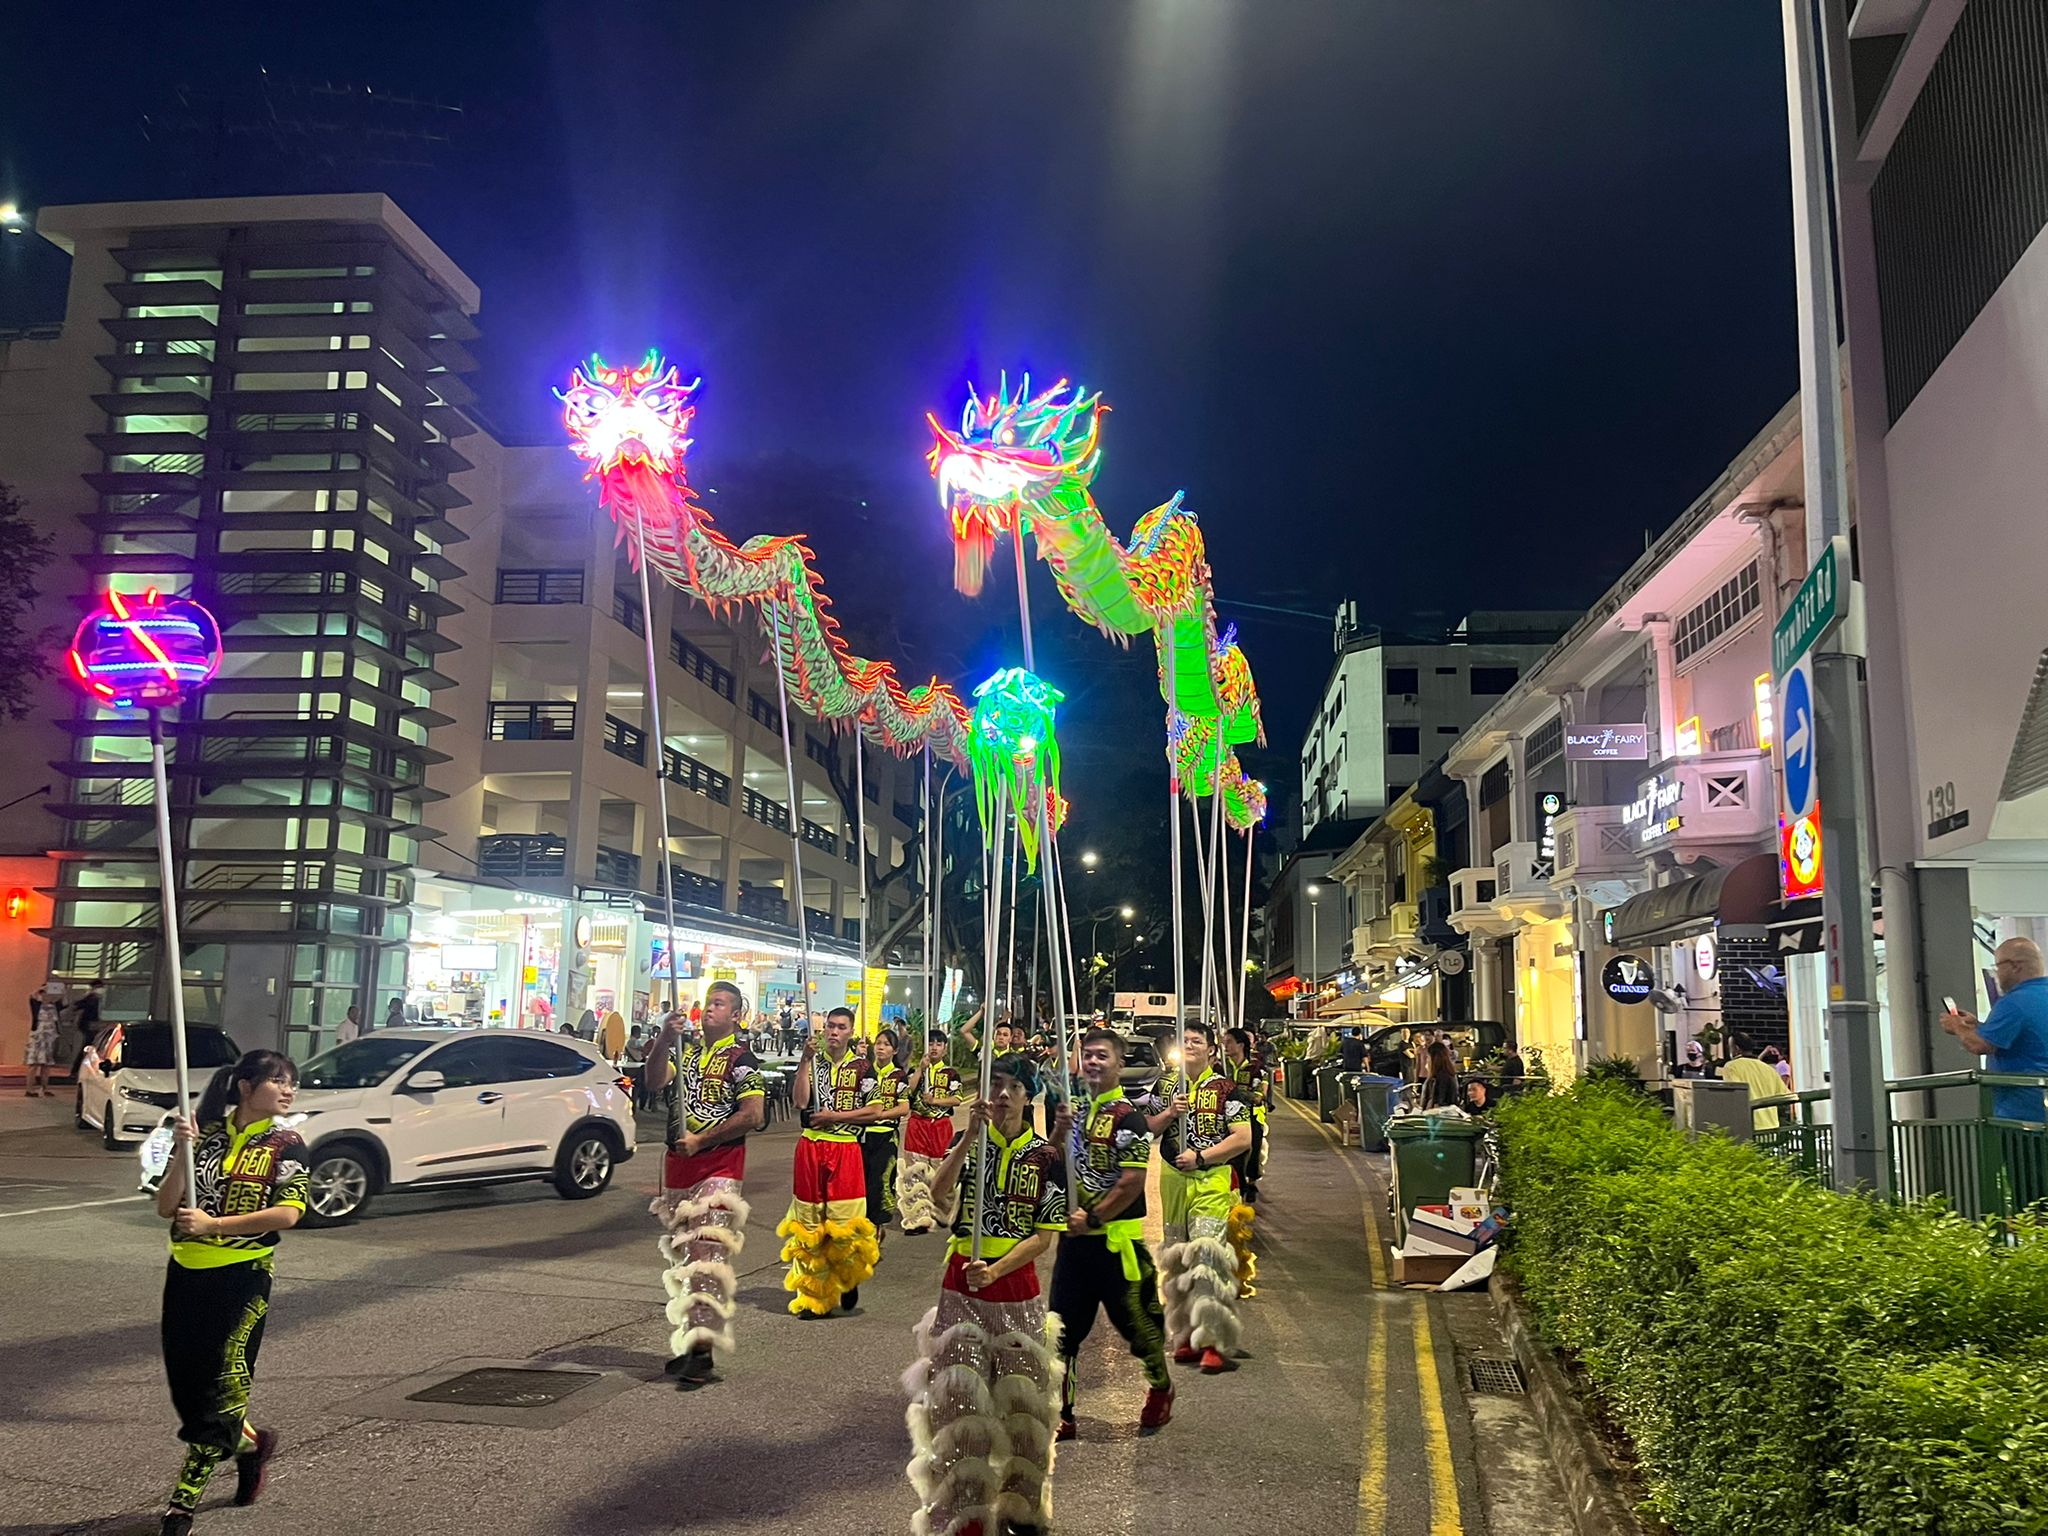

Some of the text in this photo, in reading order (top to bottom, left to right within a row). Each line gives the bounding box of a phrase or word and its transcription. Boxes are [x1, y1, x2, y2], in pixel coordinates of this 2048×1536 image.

[1775, 556, 1832, 673] Tyrwhitt Rd
[1567, 735, 1643, 745] BLACK FAIRY
[1622, 781, 1682, 824] BLACK FAIRY
[1927, 781, 1955, 823] 139
[1642, 823, 1661, 841] COFFEE
[1667, 817, 1681, 831] GRILL
[1609, 984, 1650, 994] GUINNESS
